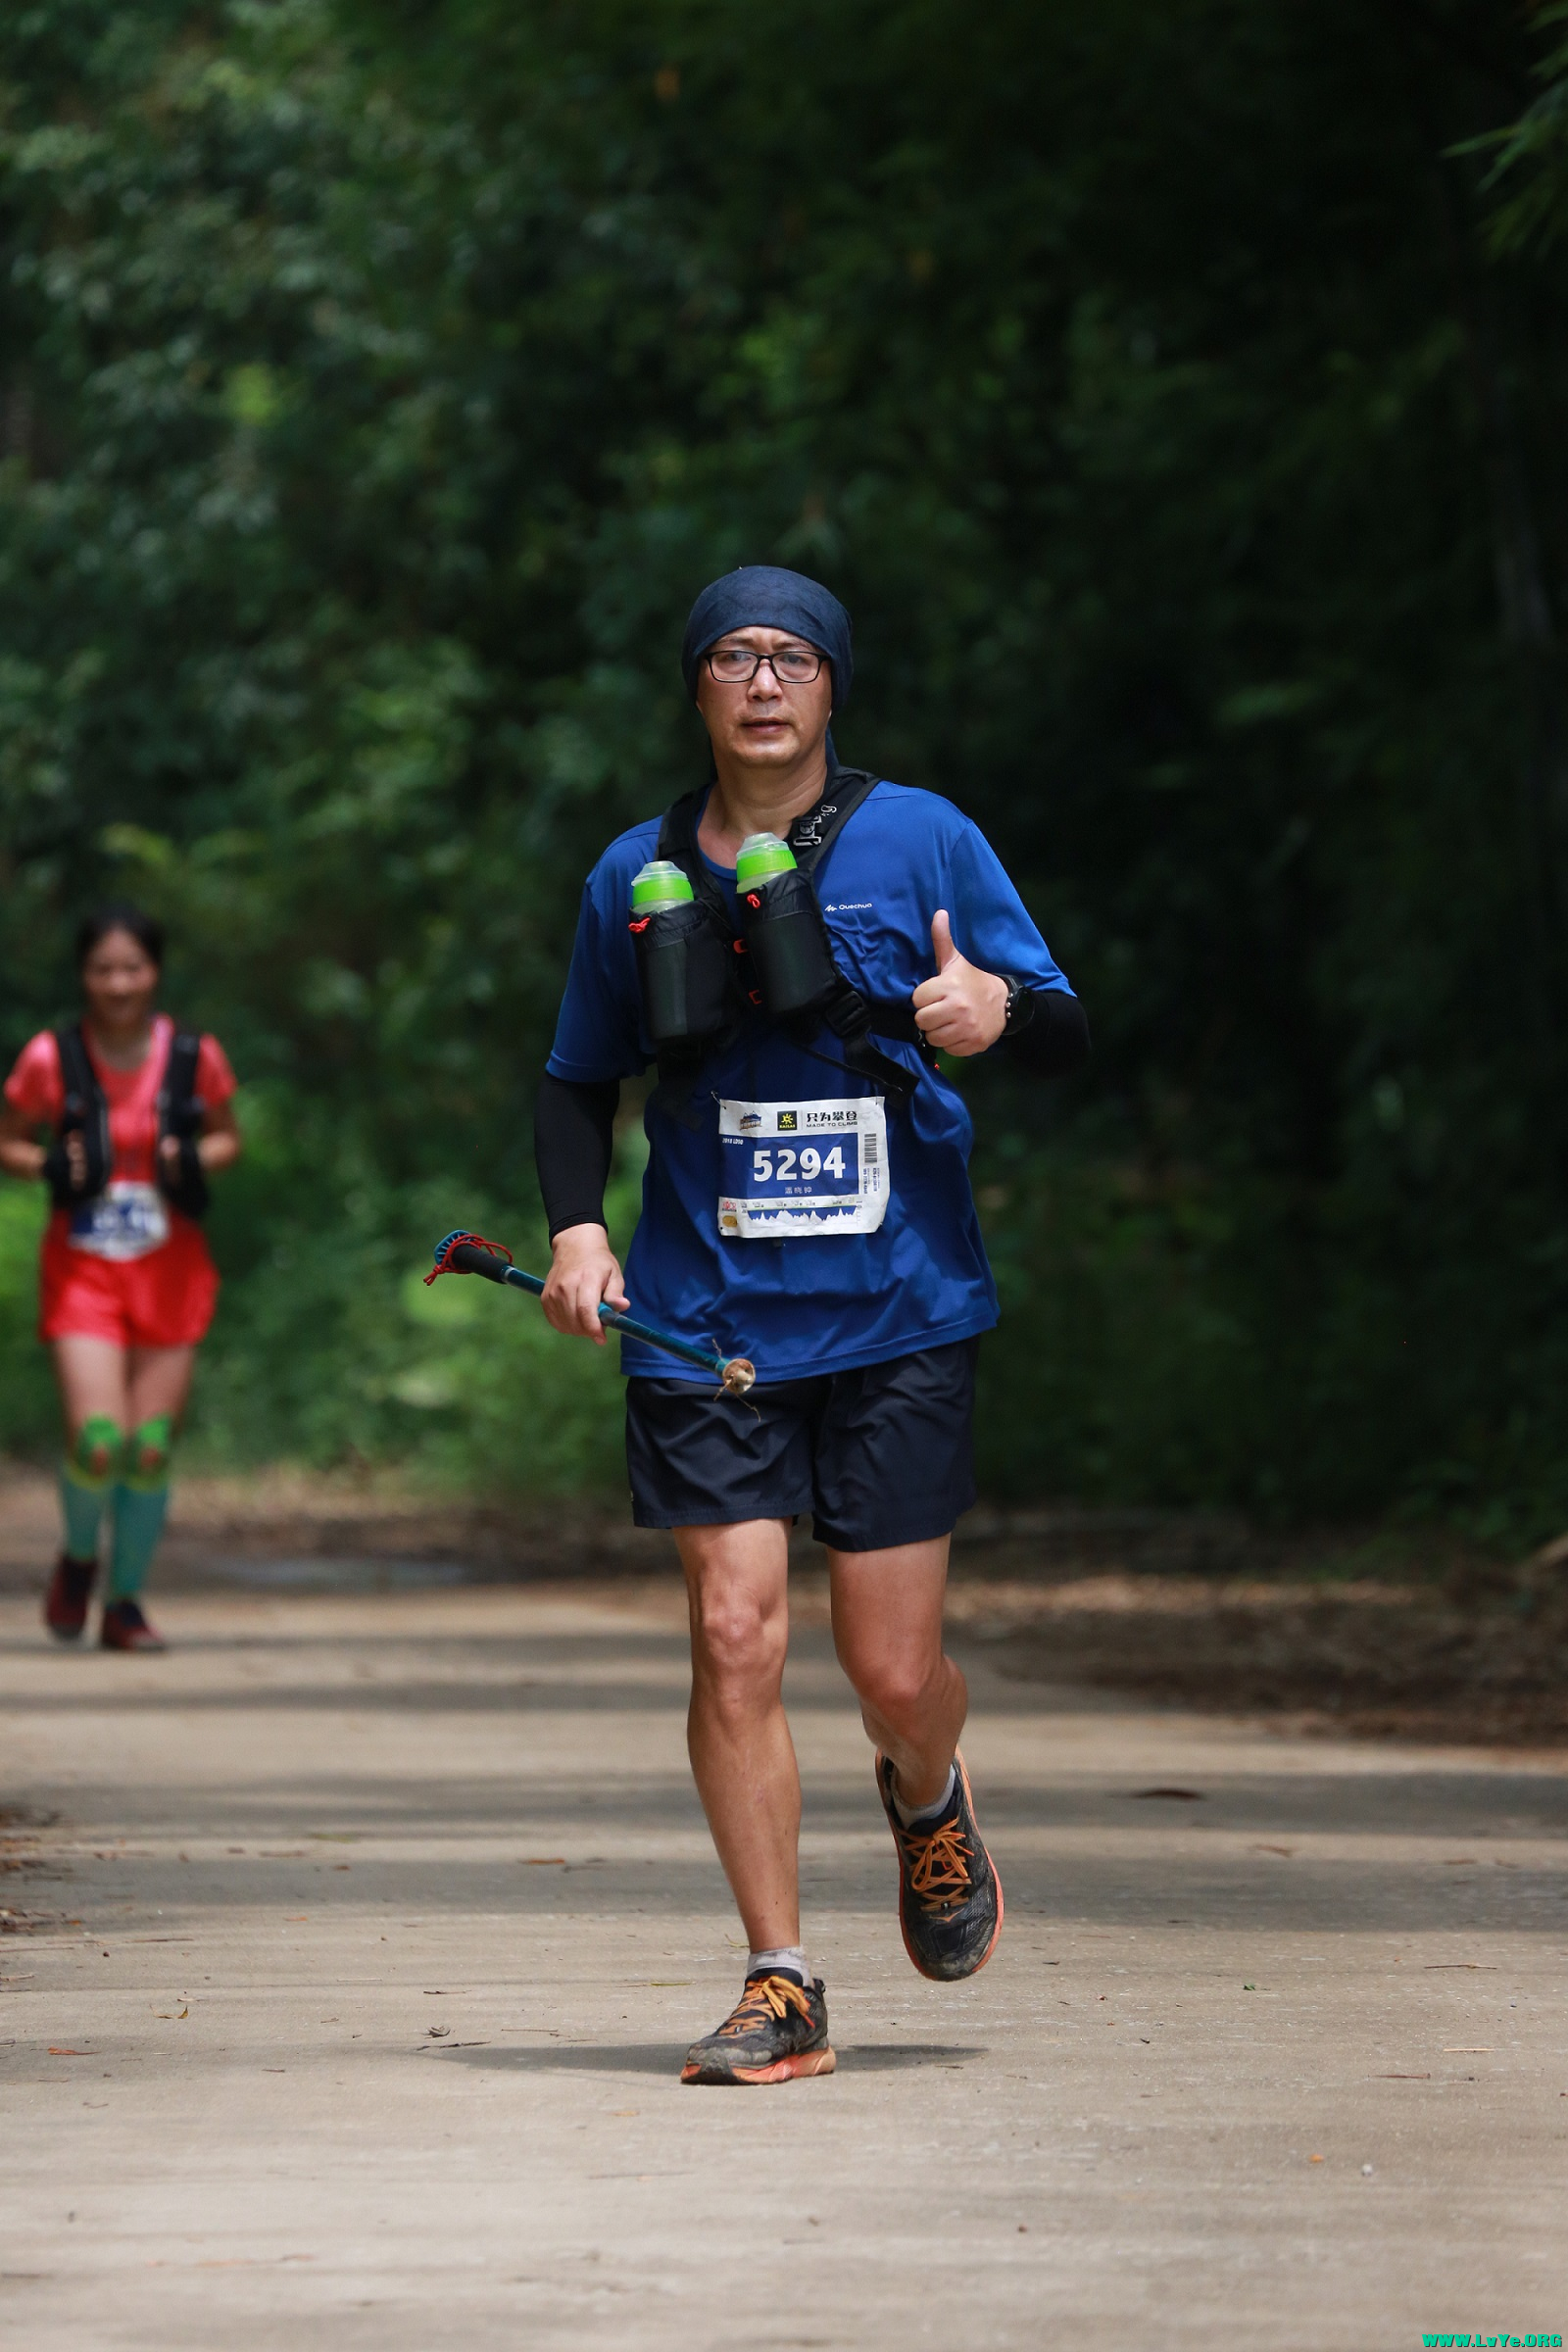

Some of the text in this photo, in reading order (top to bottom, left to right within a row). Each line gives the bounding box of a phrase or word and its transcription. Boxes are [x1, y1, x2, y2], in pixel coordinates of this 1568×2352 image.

[807, 1110, 858, 1122] 只为攀登
[754, 1147, 846, 1182] 5294
